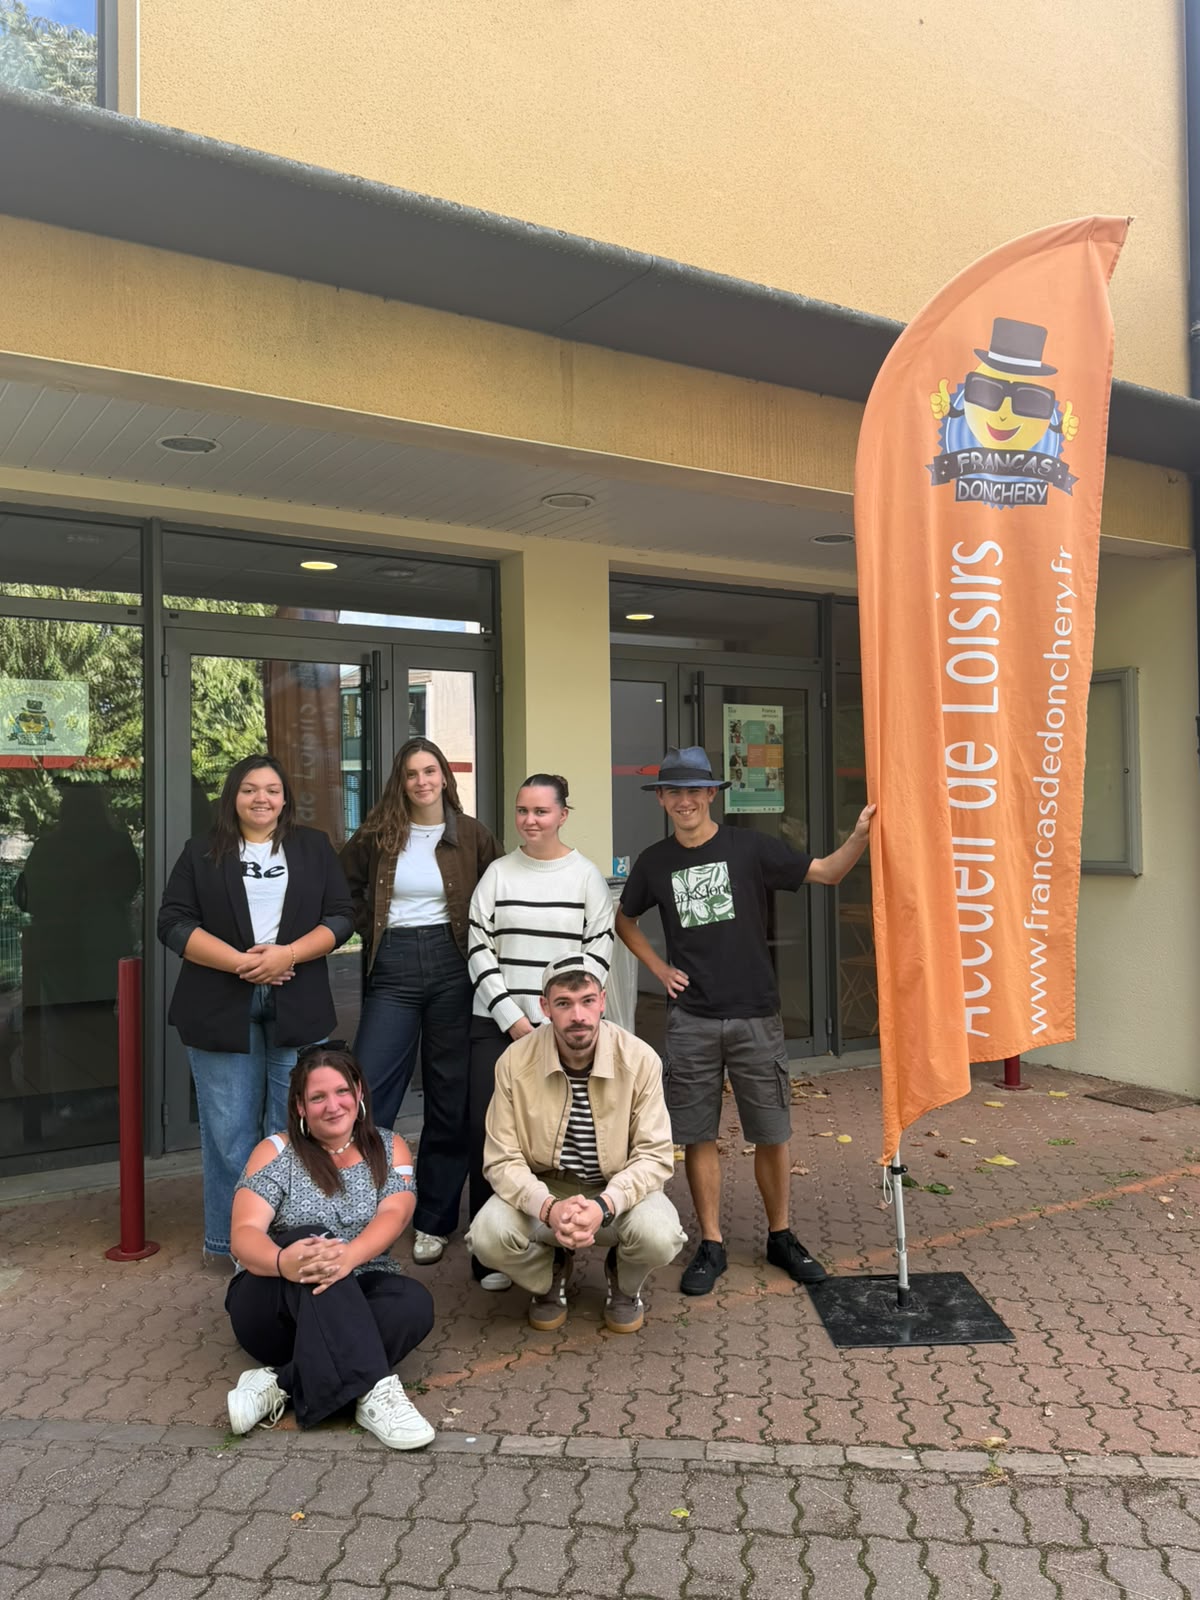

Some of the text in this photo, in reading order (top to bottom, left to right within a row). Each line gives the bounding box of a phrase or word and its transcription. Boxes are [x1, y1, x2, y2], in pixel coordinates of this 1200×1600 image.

[957, 451, 1053, 476] FRANCAS
[957, 480, 1049, 503] DONCHERY
[1024, 545, 1077, 1035] www.francasdedonchery.fr
[240, 861, 285, 879] Be
